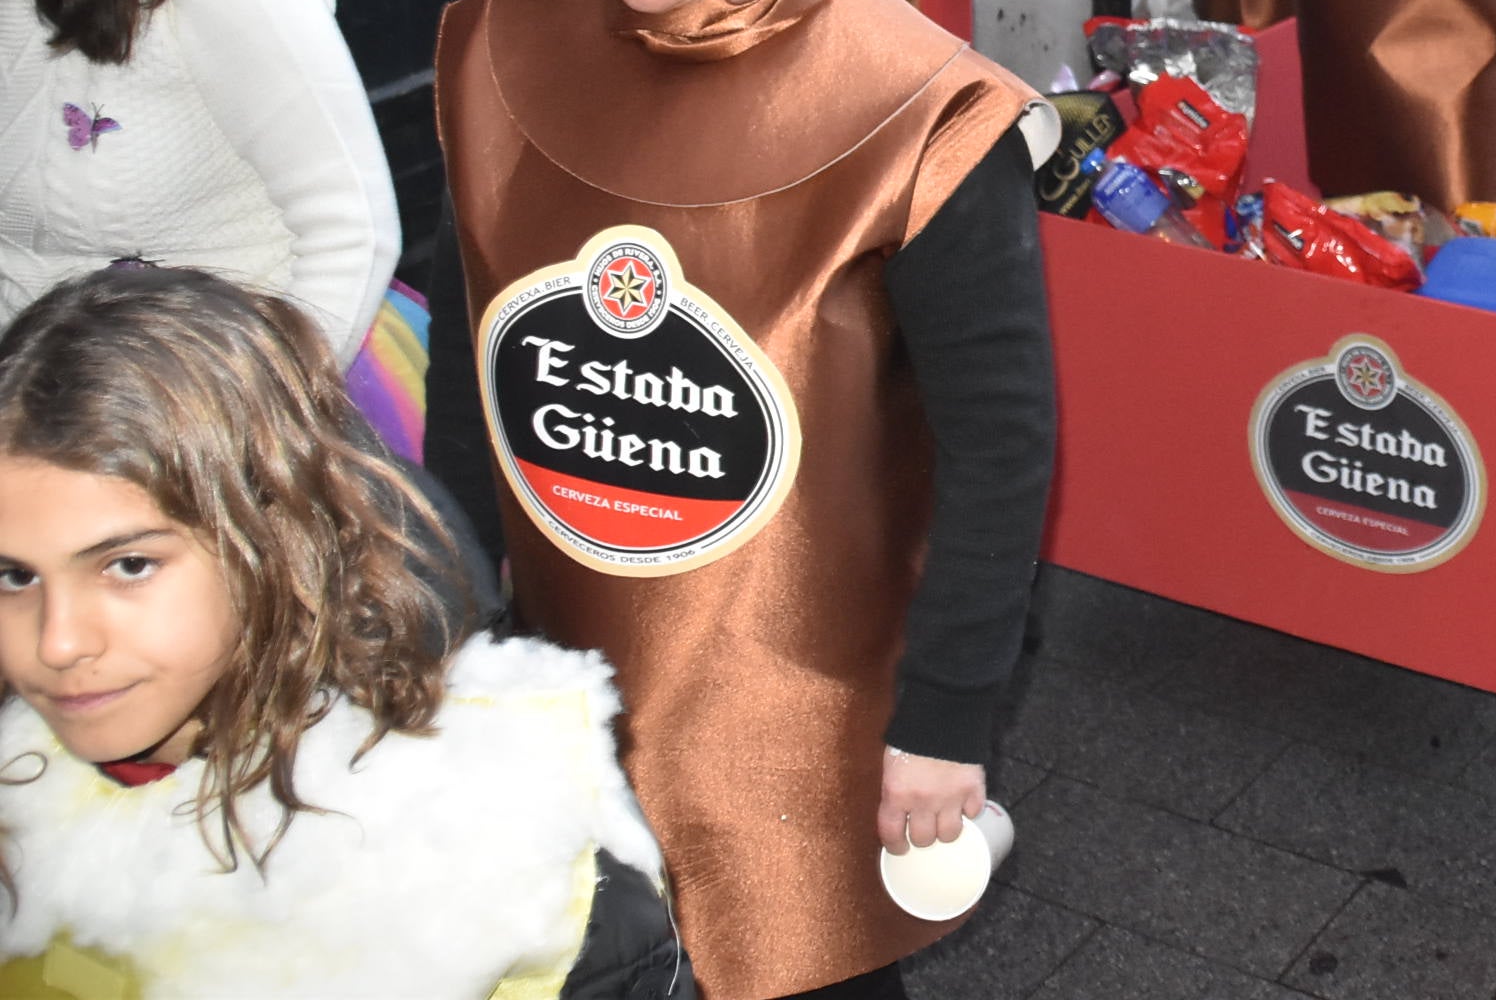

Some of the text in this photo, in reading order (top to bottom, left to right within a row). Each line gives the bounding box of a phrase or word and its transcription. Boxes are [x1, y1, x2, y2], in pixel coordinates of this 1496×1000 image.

[521, 335, 739, 419] Estaba
[531, 403, 727, 479] Güena
[1294, 405, 1448, 468] Estaba
[552, 484, 684, 521] CERVEZA ESPECIAL
[1302, 451, 1438, 509] Güena
[1316, 506, 1409, 536] CERVEZA ESPECIAL
[620, 556, 662, 564] DESDE
